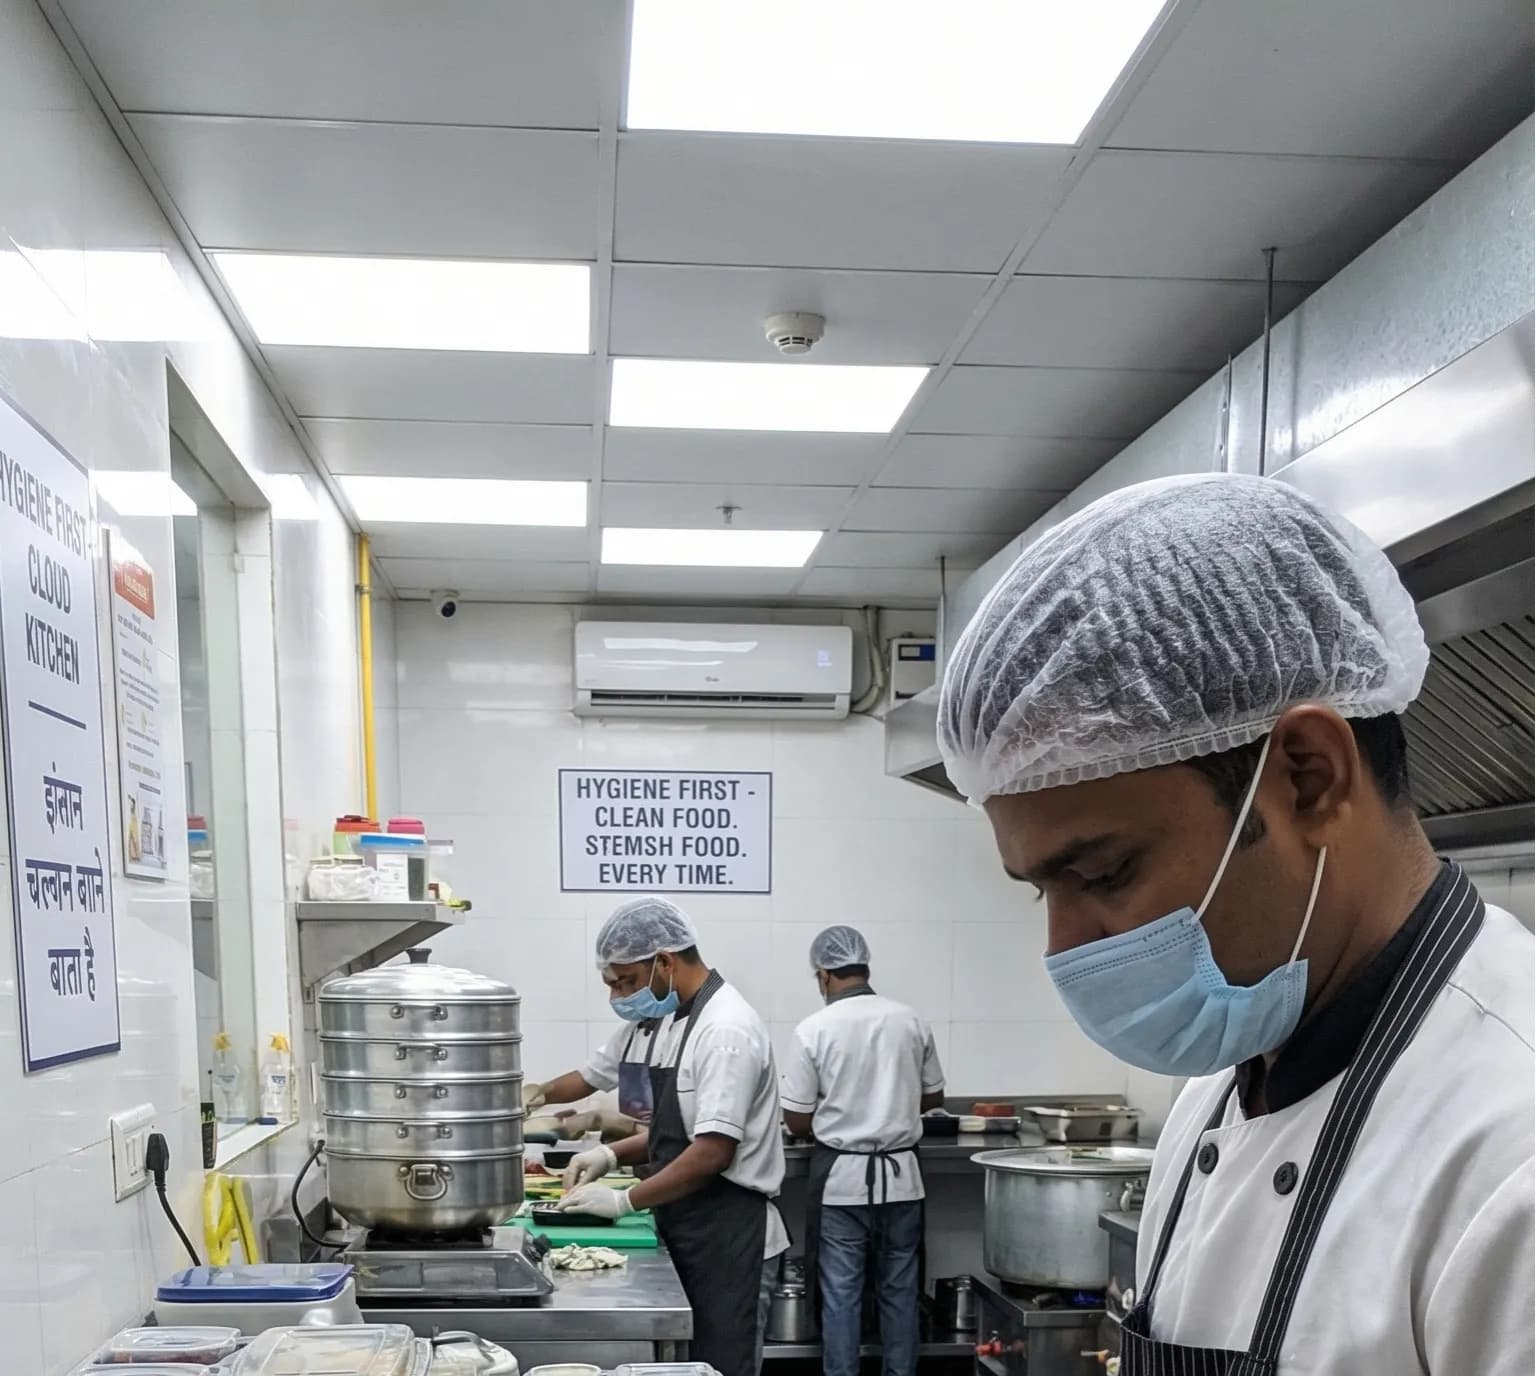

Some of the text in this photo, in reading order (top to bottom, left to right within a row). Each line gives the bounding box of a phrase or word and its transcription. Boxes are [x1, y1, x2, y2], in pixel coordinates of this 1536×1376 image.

[28, 543, 71, 614] CLOUD
[25, 612, 80, 685] KITCHEN
[576, 777, 671, 800] HYGIENE
[679, 779, 740, 801] FIRST
[595, 806, 738, 829] CLEAN FOOD.
[585, 834, 747, 857] STEMSH FOOD.
[599, 863, 734, 885] EVERY TIME.
